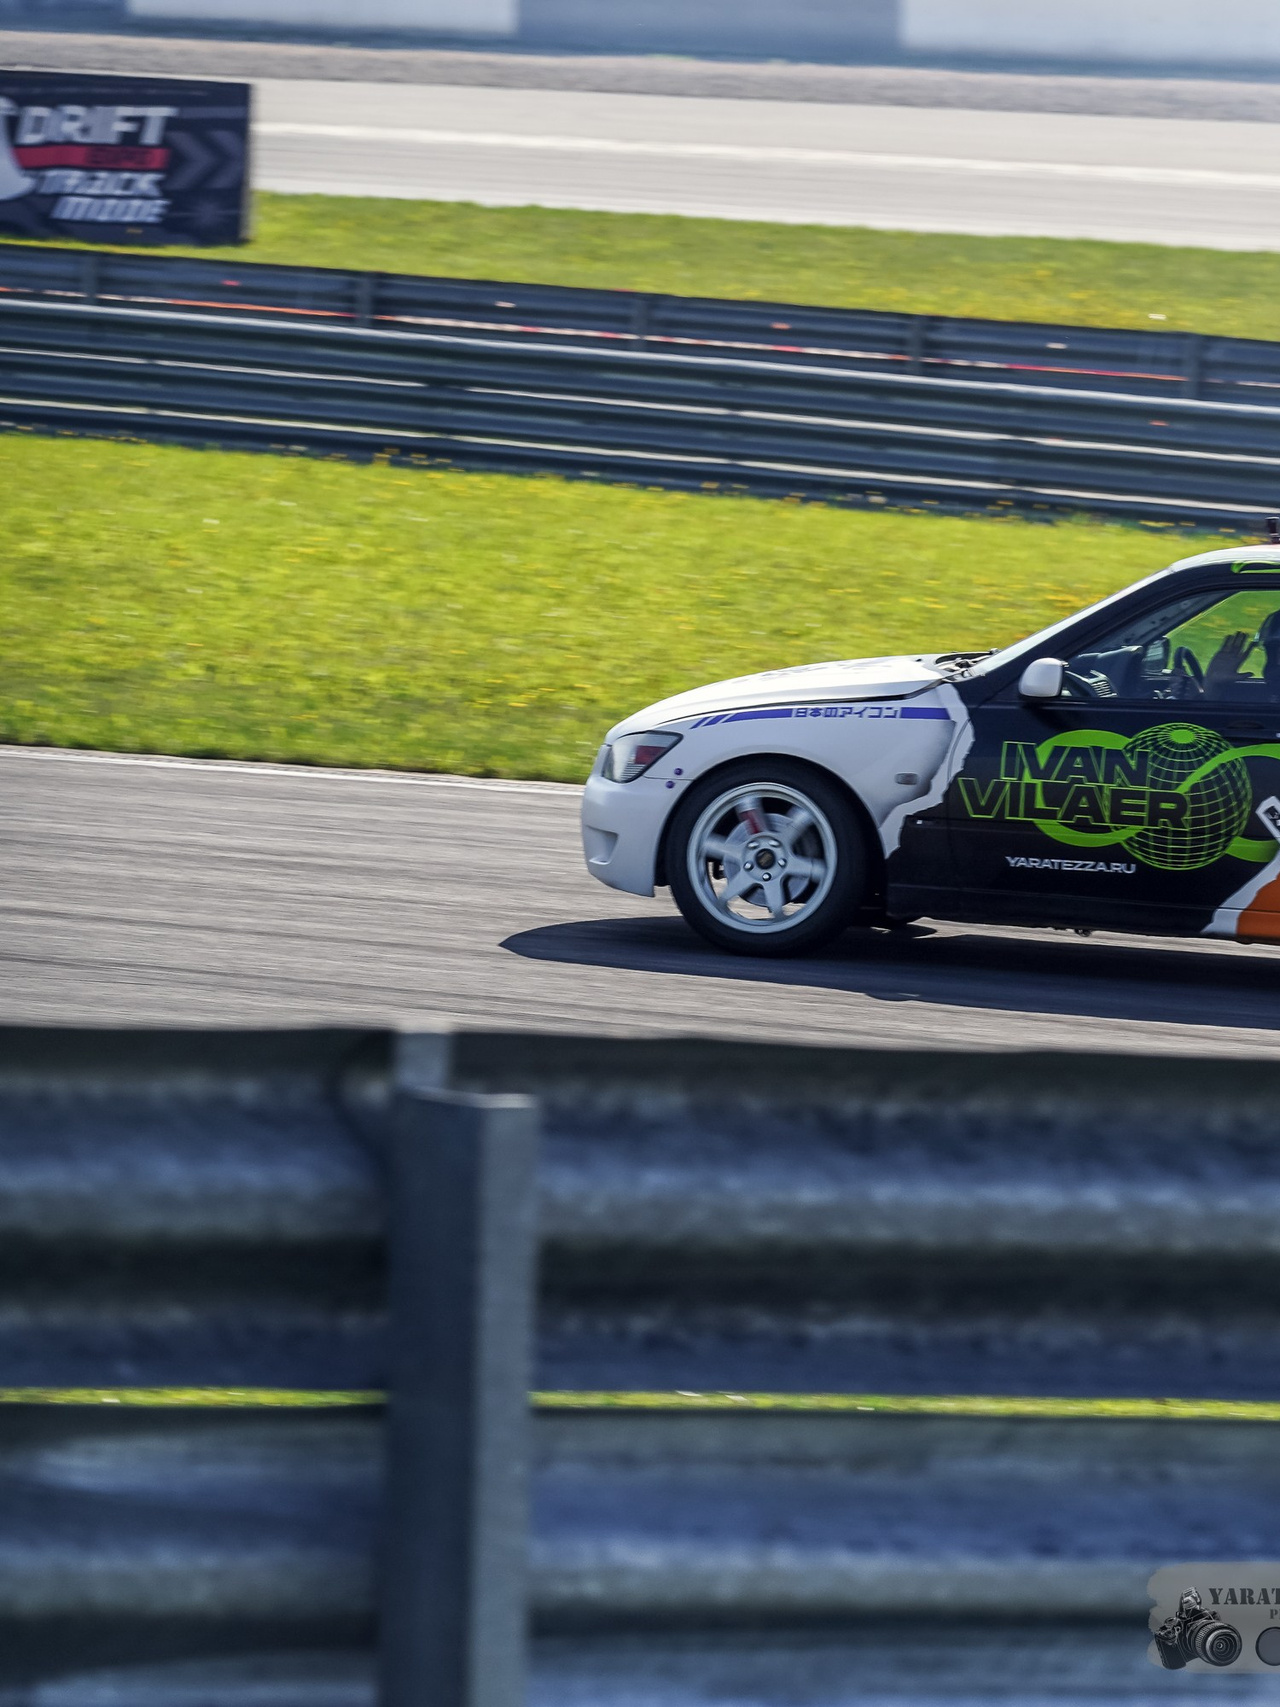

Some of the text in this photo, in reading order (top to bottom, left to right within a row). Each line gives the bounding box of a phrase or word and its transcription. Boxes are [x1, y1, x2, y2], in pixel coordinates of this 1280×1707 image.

[17, 105, 178, 145] DRIFT
[1001, 741, 1150, 788] IVAN
[958, 778, 1191, 830] VILAER
[1006, 856, 1136, 874] YARATEZZA.RU
